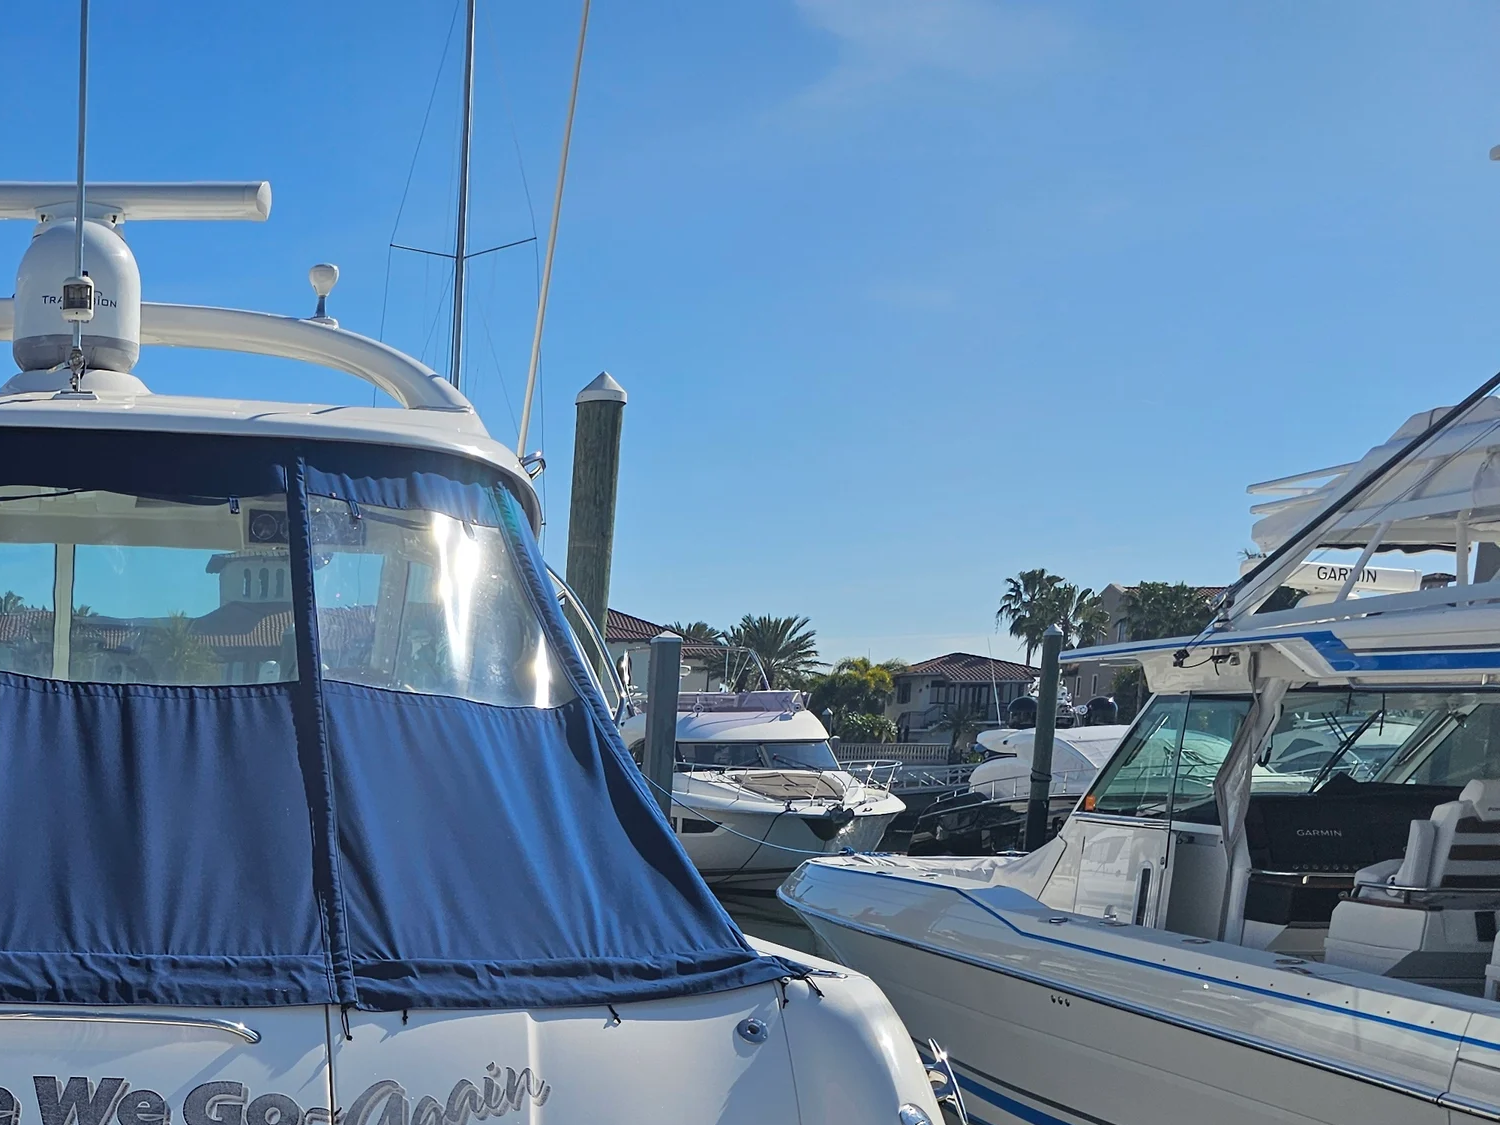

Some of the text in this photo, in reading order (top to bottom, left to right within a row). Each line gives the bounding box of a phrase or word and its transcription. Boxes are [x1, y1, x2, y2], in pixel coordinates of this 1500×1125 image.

[42, 295, 117, 308] TRAION
[1317, 566, 1377, 583] GARIN
[1296, 829, 1342, 837] GARMIN
